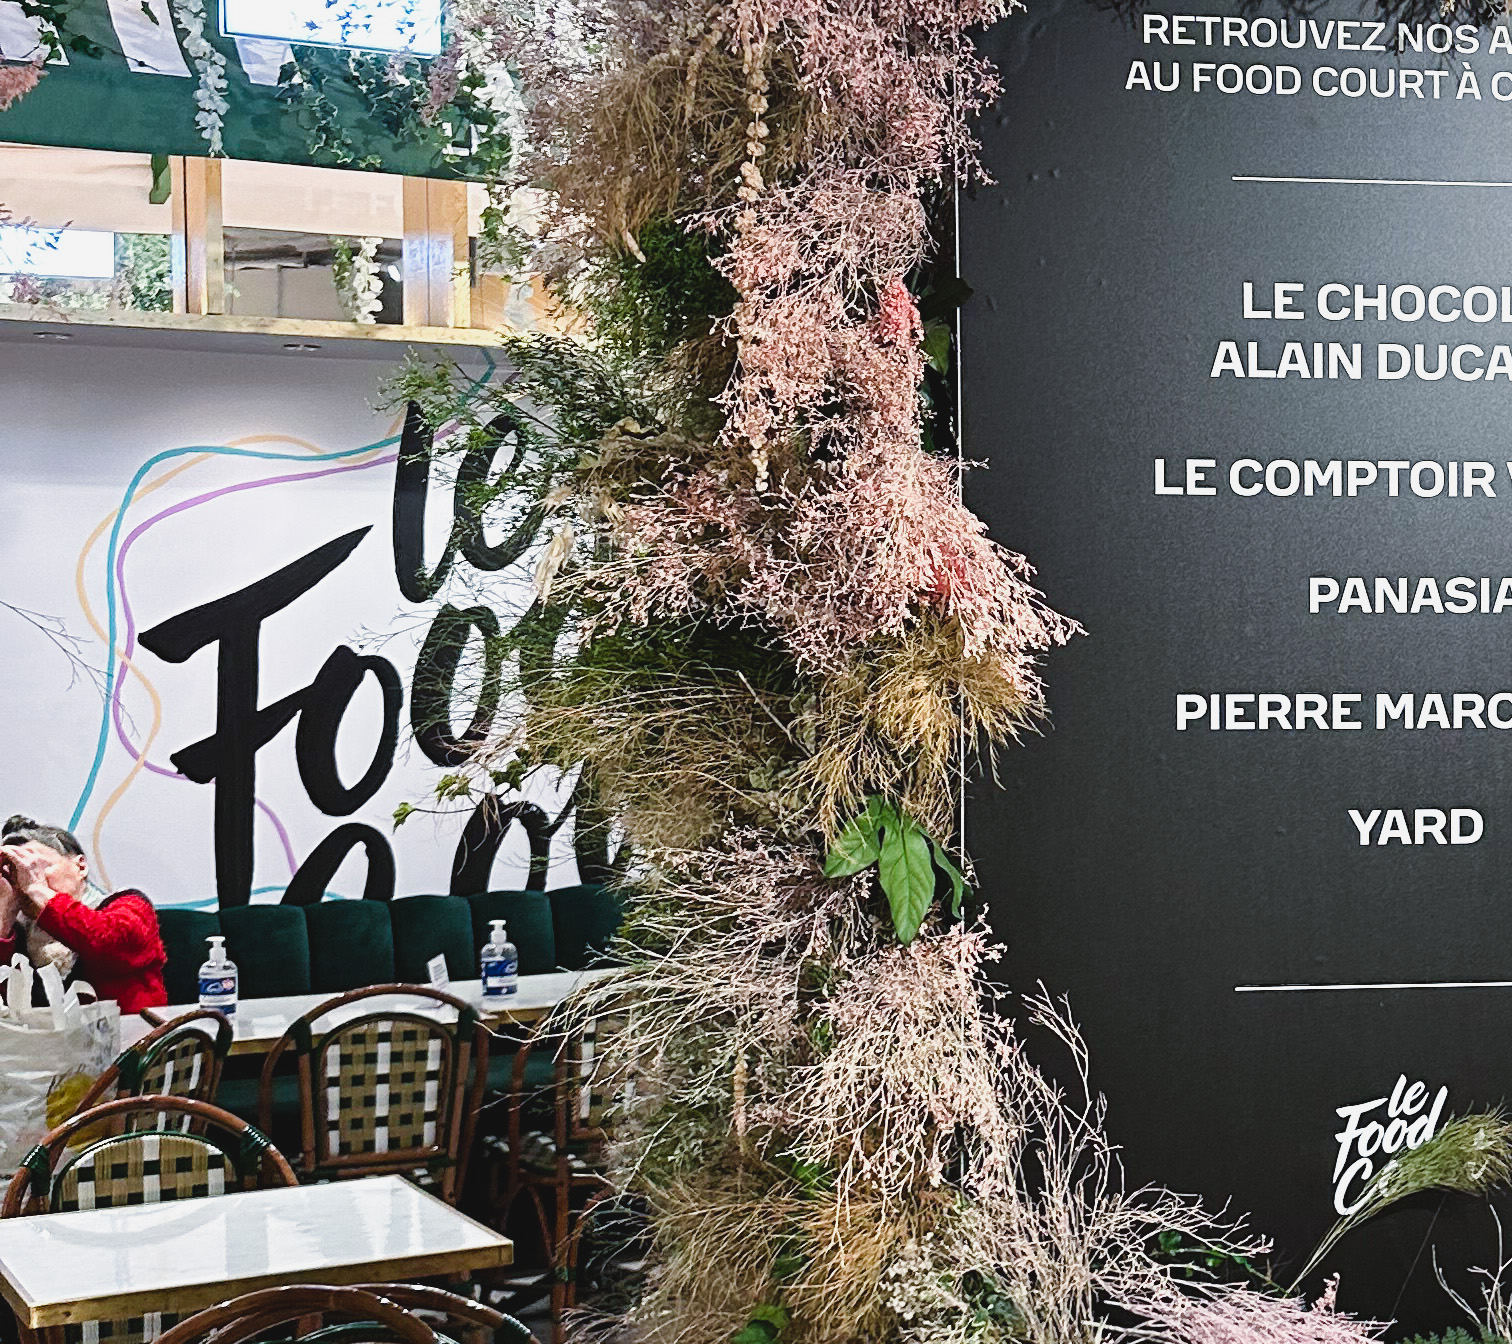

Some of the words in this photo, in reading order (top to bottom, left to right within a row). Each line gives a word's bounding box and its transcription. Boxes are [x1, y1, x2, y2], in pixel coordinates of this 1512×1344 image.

[1143, 14, 1386, 52] RETROUVEZ
[1398, 22, 1480, 55] NOS
[1125, 60, 1180, 92] AU
[1193, 62, 1302, 96] FOOD
[1312, 66, 1450, 101] COURT
[1455, 61, 1482, 101] À
[1243, 281, 1305, 320] LE
[1210, 340, 1362, 380] ALAIN
[1154, 458, 1217, 496] LE
[1229, 458, 1497, 498] COMPTOIR
[1176, 693, 1362, 731] PIERRE
[1347, 808, 1484, 846] YARD
[1332, 1085, 1449, 1185] Food
